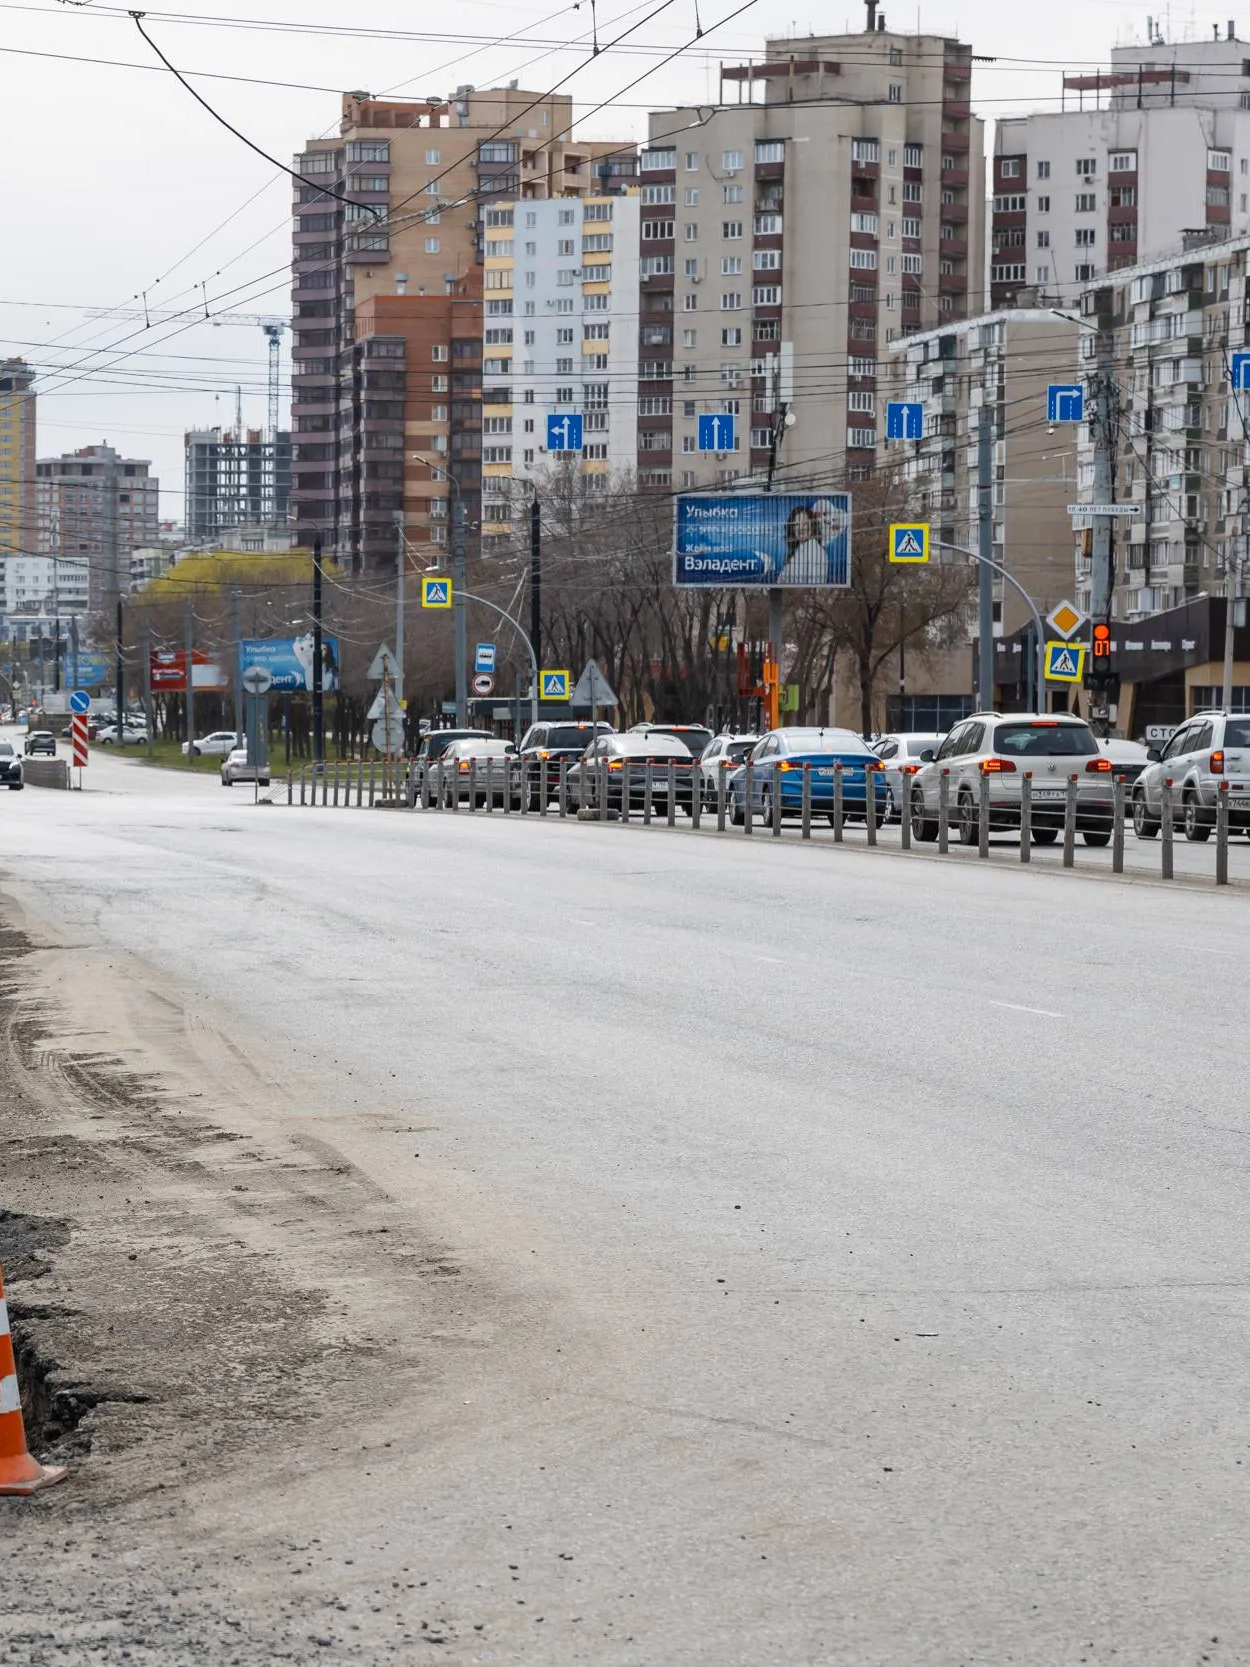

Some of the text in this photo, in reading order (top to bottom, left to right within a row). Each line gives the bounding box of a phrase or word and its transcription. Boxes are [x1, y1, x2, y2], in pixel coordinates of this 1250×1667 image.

[686, 505, 738, 518] Улыбка
[685, 556, 758, 573] Вэладент
[1094, 640, 1110, 656] 07
